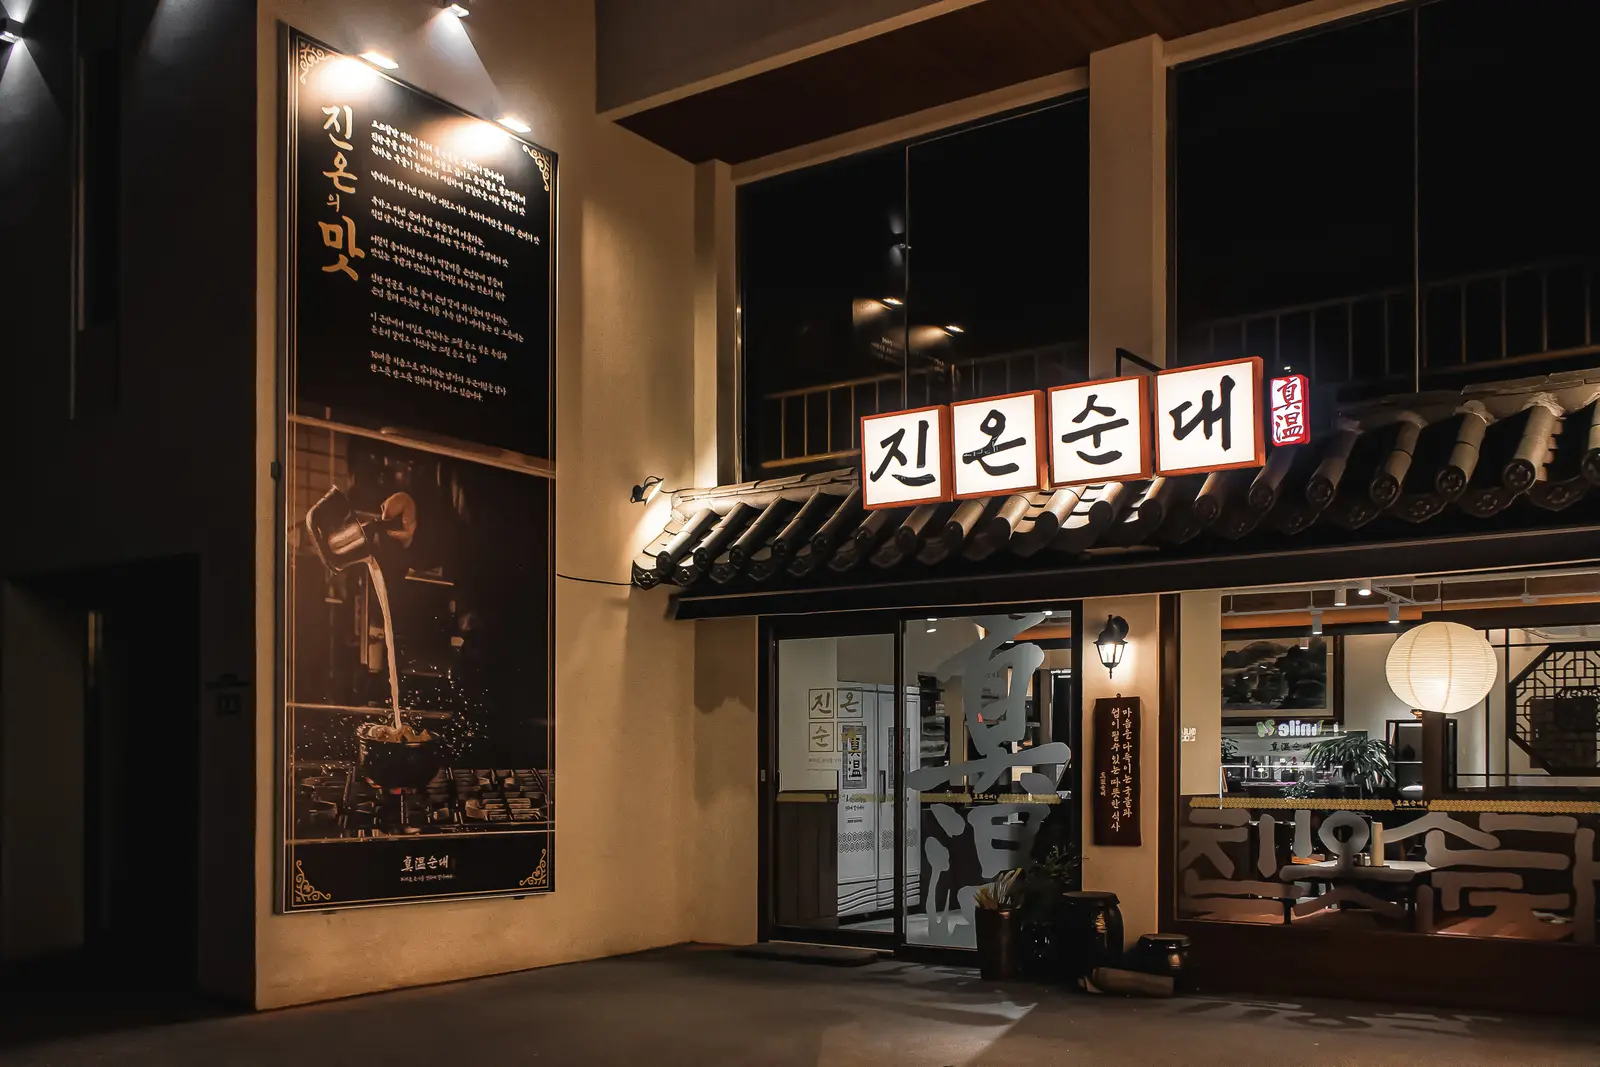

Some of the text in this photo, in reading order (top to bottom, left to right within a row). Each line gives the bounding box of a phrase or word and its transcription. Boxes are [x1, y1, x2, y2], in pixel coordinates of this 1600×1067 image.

[318, 105, 365, 282] 진온의 맛
[870, 375, 1236, 487] 진온순대
[1110, 777, 1121, 809] 따뜻한
[1122, 707, 1133, 818] 마음을 다독이는 국물과
[1110, 811, 1121, 832] 식사
